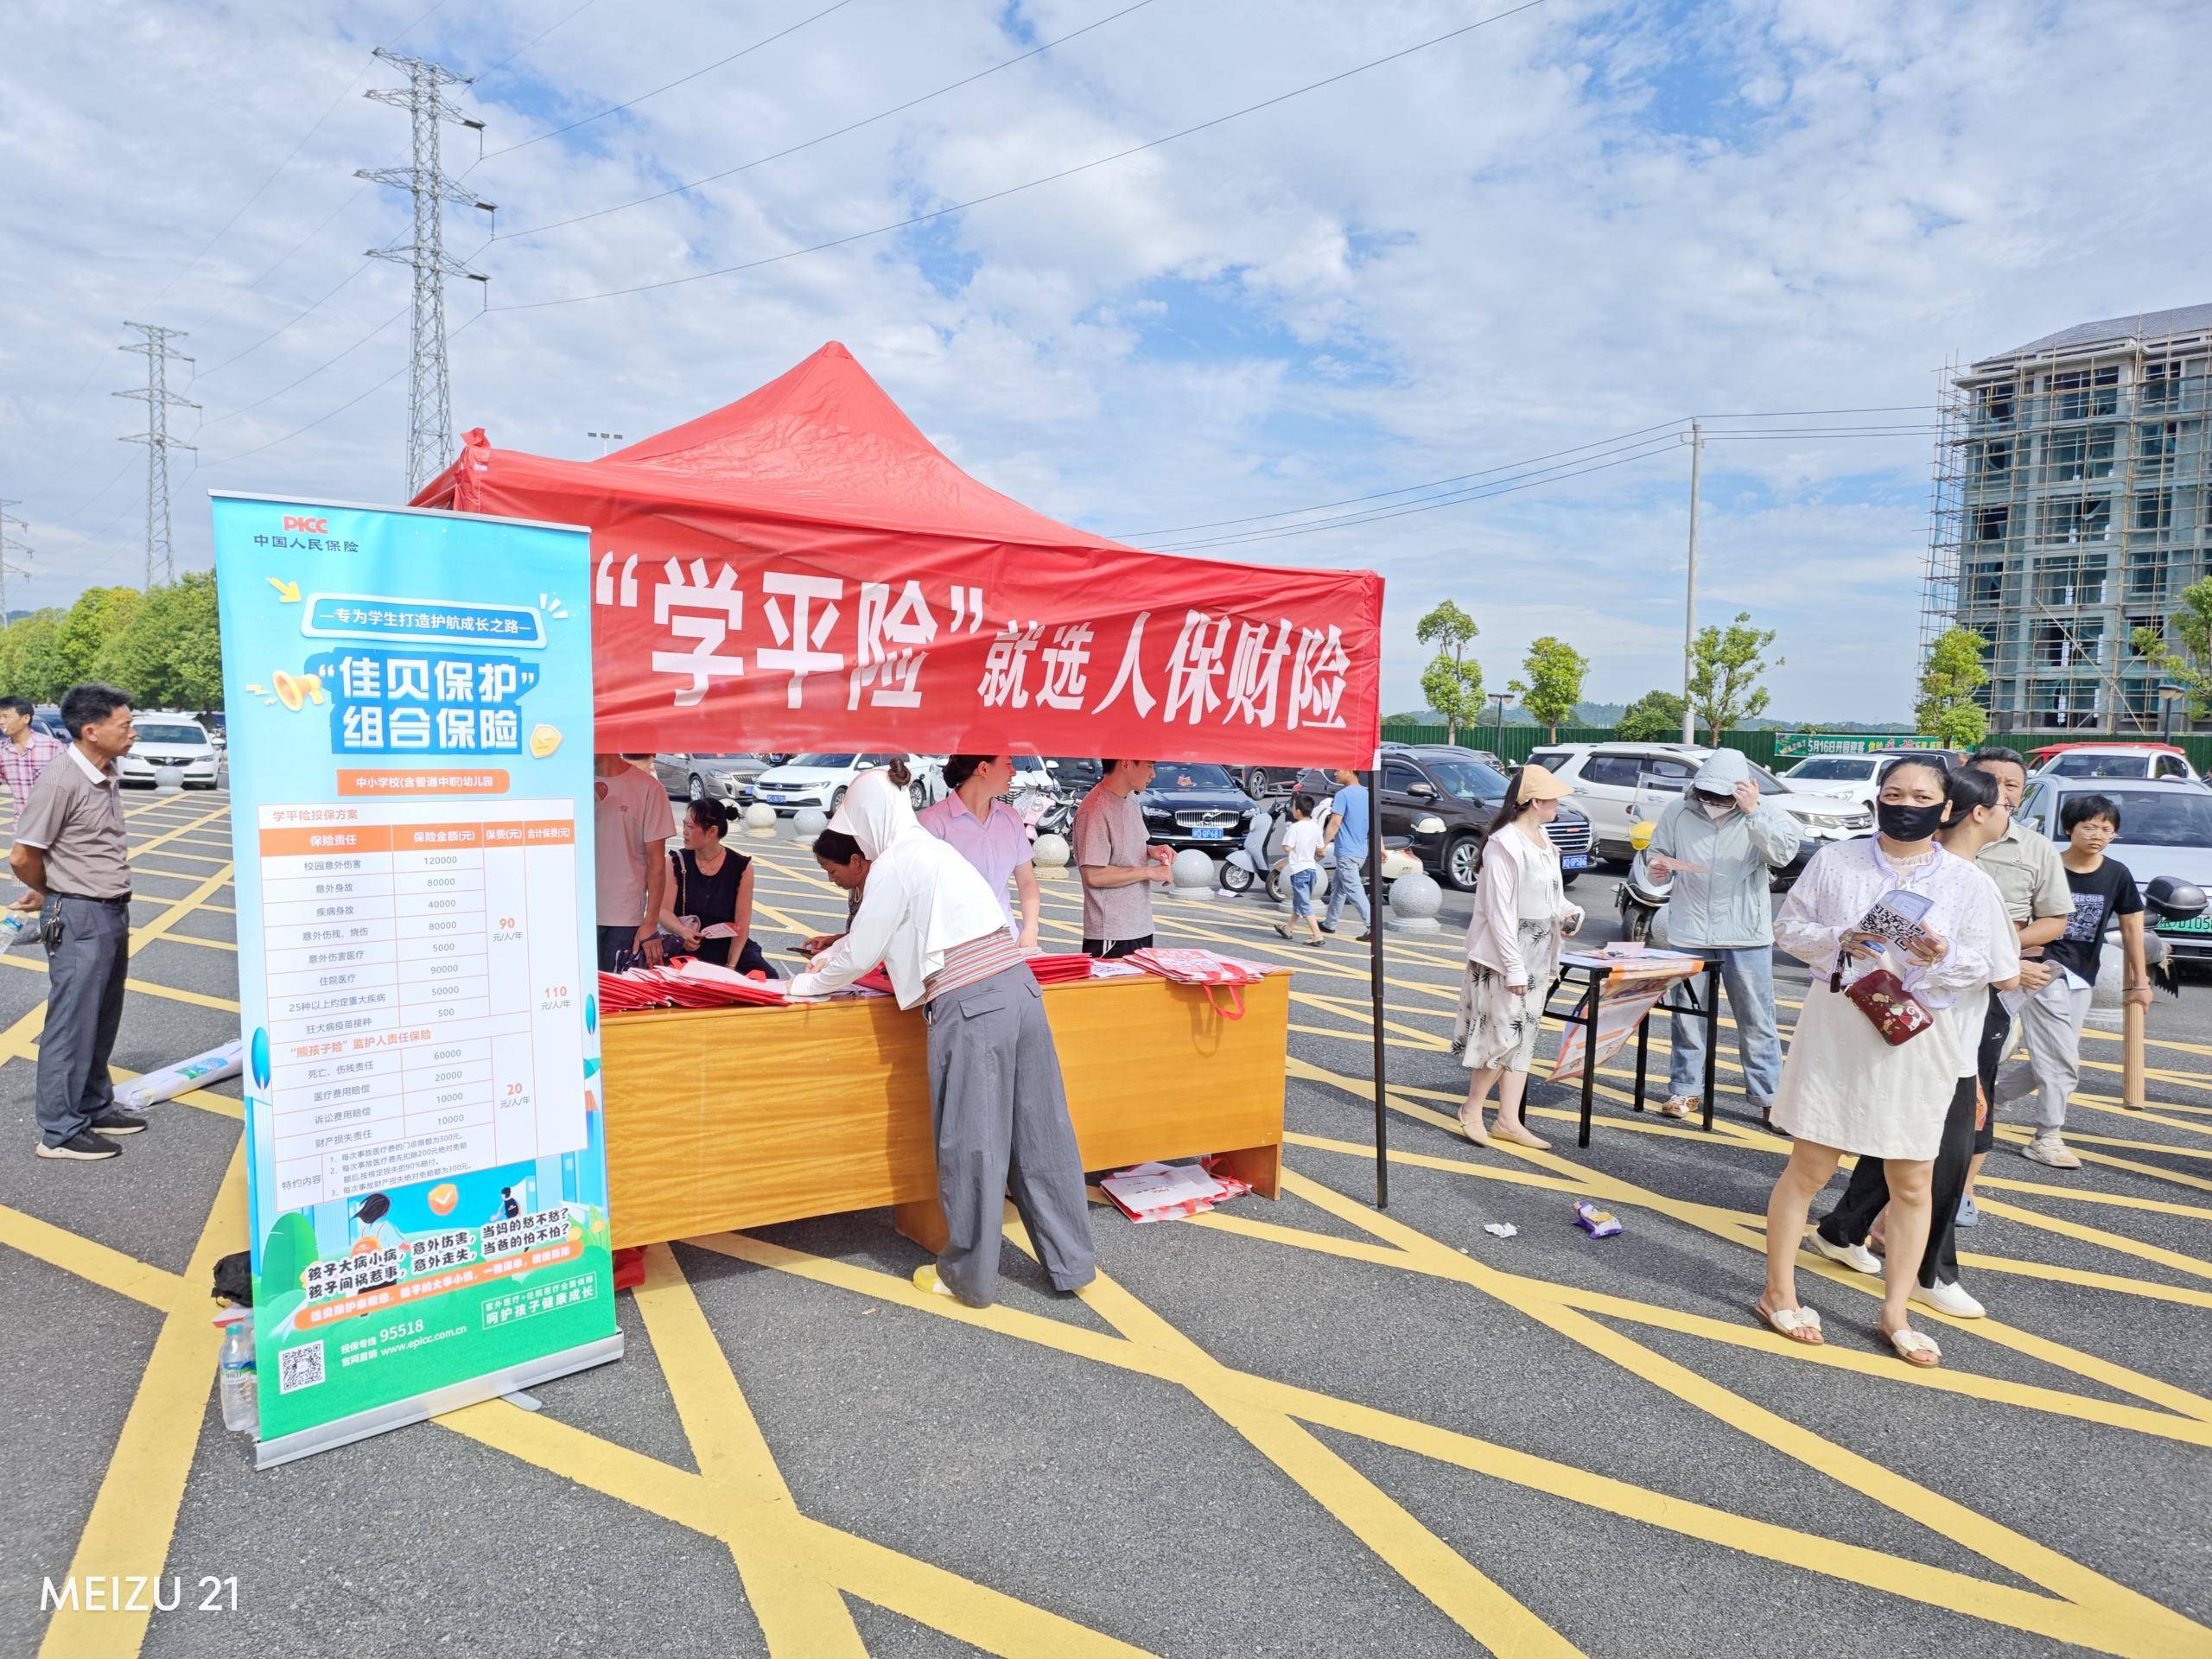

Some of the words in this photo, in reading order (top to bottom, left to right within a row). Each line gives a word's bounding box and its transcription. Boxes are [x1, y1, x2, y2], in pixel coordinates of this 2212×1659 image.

[283, 516, 328, 534] PICC
[253, 534, 359, 553] 中国人民保险
[342, 706, 518, 750] 组合保险
[272, 809, 359, 822] 学平险投保方案
[309, 835, 357, 847] 保险责任
[413, 830, 476, 842] 保险金额(元)
[486, 829, 522, 841] 保费(元)
[303, 859, 362, 872] 校园意外伤害
[423, 855, 457, 865] 120000
[315, 882, 353, 893] 意外身故
[427, 877, 455, 887] 80000
[428, 899, 456, 908] 40000
[316, 906, 354, 917] 疾病身故
[429, 921, 457, 931] 80000
[499, 918, 515, 930] 90
[493, 931, 524, 943] 元/人/年
[432, 943, 455, 952] 5000
[308, 950, 365, 964] 意外伤害医疗
[430, 964, 459, 975] 90000
[319, 974, 357, 987] 住院医疗
[432, 986, 460, 996] 50000
[544, 986, 568, 999] 110
[541, 999, 571, 1012] 元/人/年
[438, 1007, 454, 1018] 500
[434, 1048, 462, 1060] 60000
[435, 1070, 462, 1082] 20000
[314, 1084, 371, 1103] 医疗费用赔偿
[506, 1082, 523, 1096] 20
[436, 1092, 464, 1104] 10000
[499, 1095, 531, 1109] 元/人/年
[315, 1107, 372, 1125] 诉讼费用赔偿
[437, 1113, 465, 1126] 10000
[315, 1128, 372, 1148] 财产损失责任
[282, 1173, 322, 1191] 特约内容
[380, 1319, 424, 1343] 95518
[380, 1325, 467, 1357] www.epicc.com.cn
